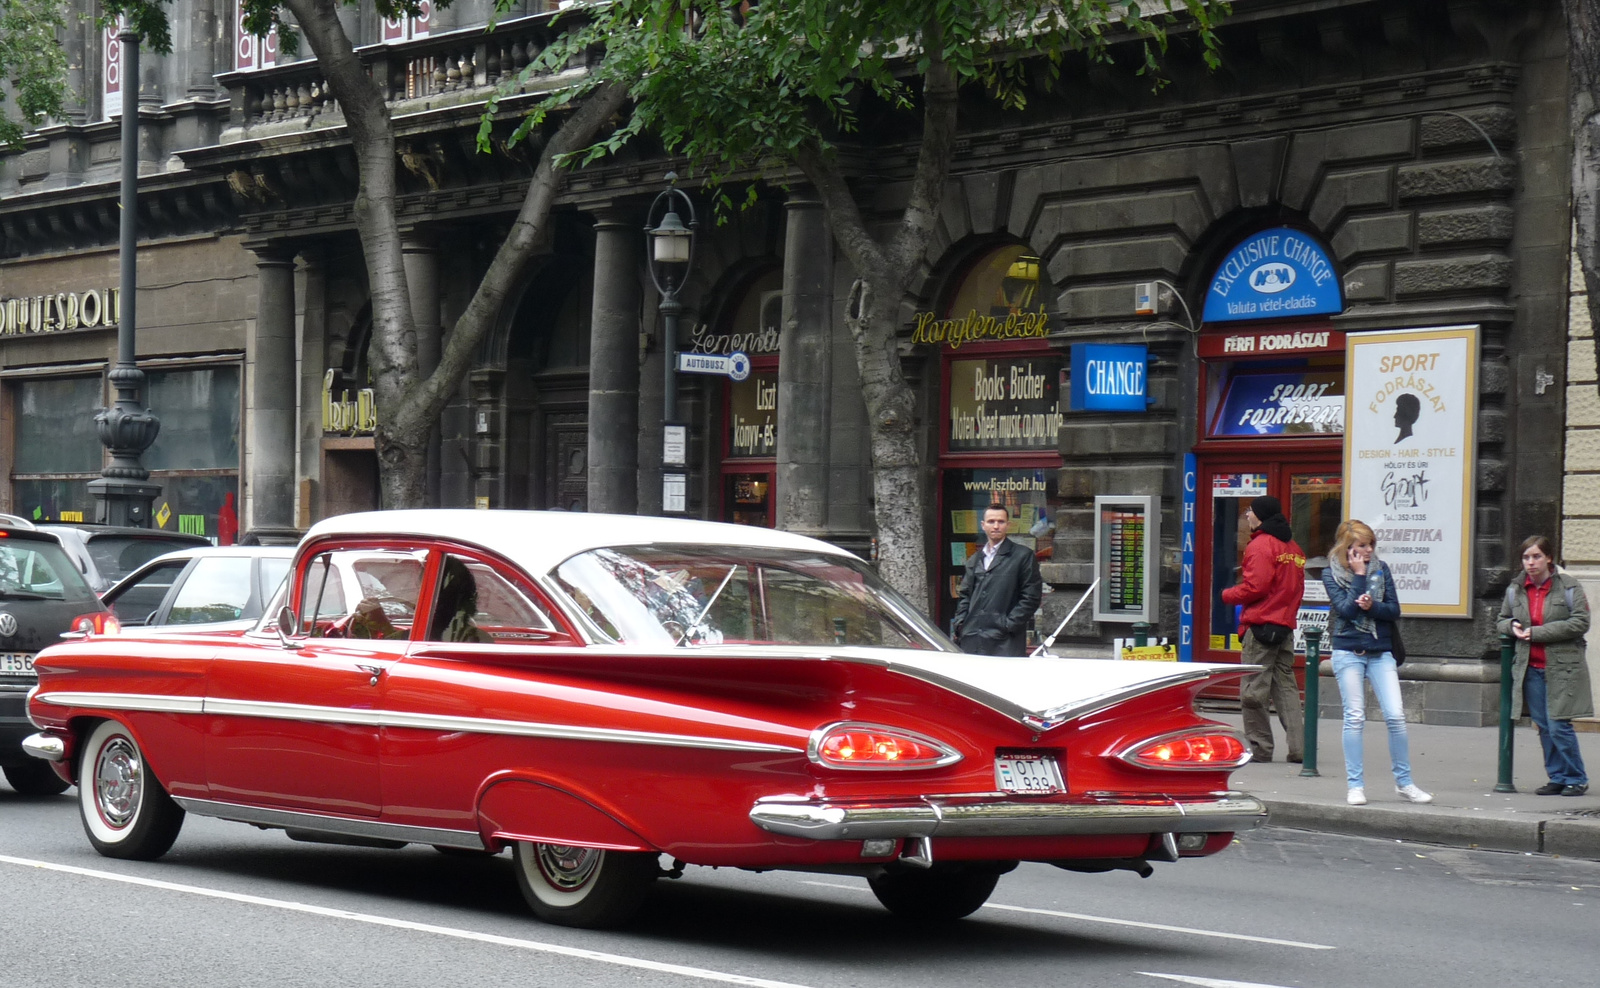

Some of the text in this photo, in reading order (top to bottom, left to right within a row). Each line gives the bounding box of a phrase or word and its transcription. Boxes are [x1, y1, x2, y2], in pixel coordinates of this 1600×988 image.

[1213, 236, 1332, 297] EXCLUSIVE CHANGE
[1227, 295, 1317, 314] Valuta vétel-eladás
[1224, 331, 1330, 352] FÉRFI FODRÁSZAT
[686, 358, 725, 370] AUTÓBUSZ
[1085, 359, 1144, 396] CHANGE
[1379, 353, 1440, 373] SPORT
[757, 379, 776, 410] Liszt
[975, 362, 1046, 401] Books Bücher
[1369, 373, 1446, 414] FODRÁSZAT
[764, 415, 774, 446] és
[952, 406, 975, 440] Noten
[976, 403, 998, 439] Sheet
[999, 406, 1021, 439] music
[1359, 447, 1455, 459] DESIGN HAIR STYLE
[964, 477, 1047, 491] www.lisztbolt.hu
[1398, 513, 1427, 521] 352-1335
[1180, 471, 1196, 646] CHANGE
